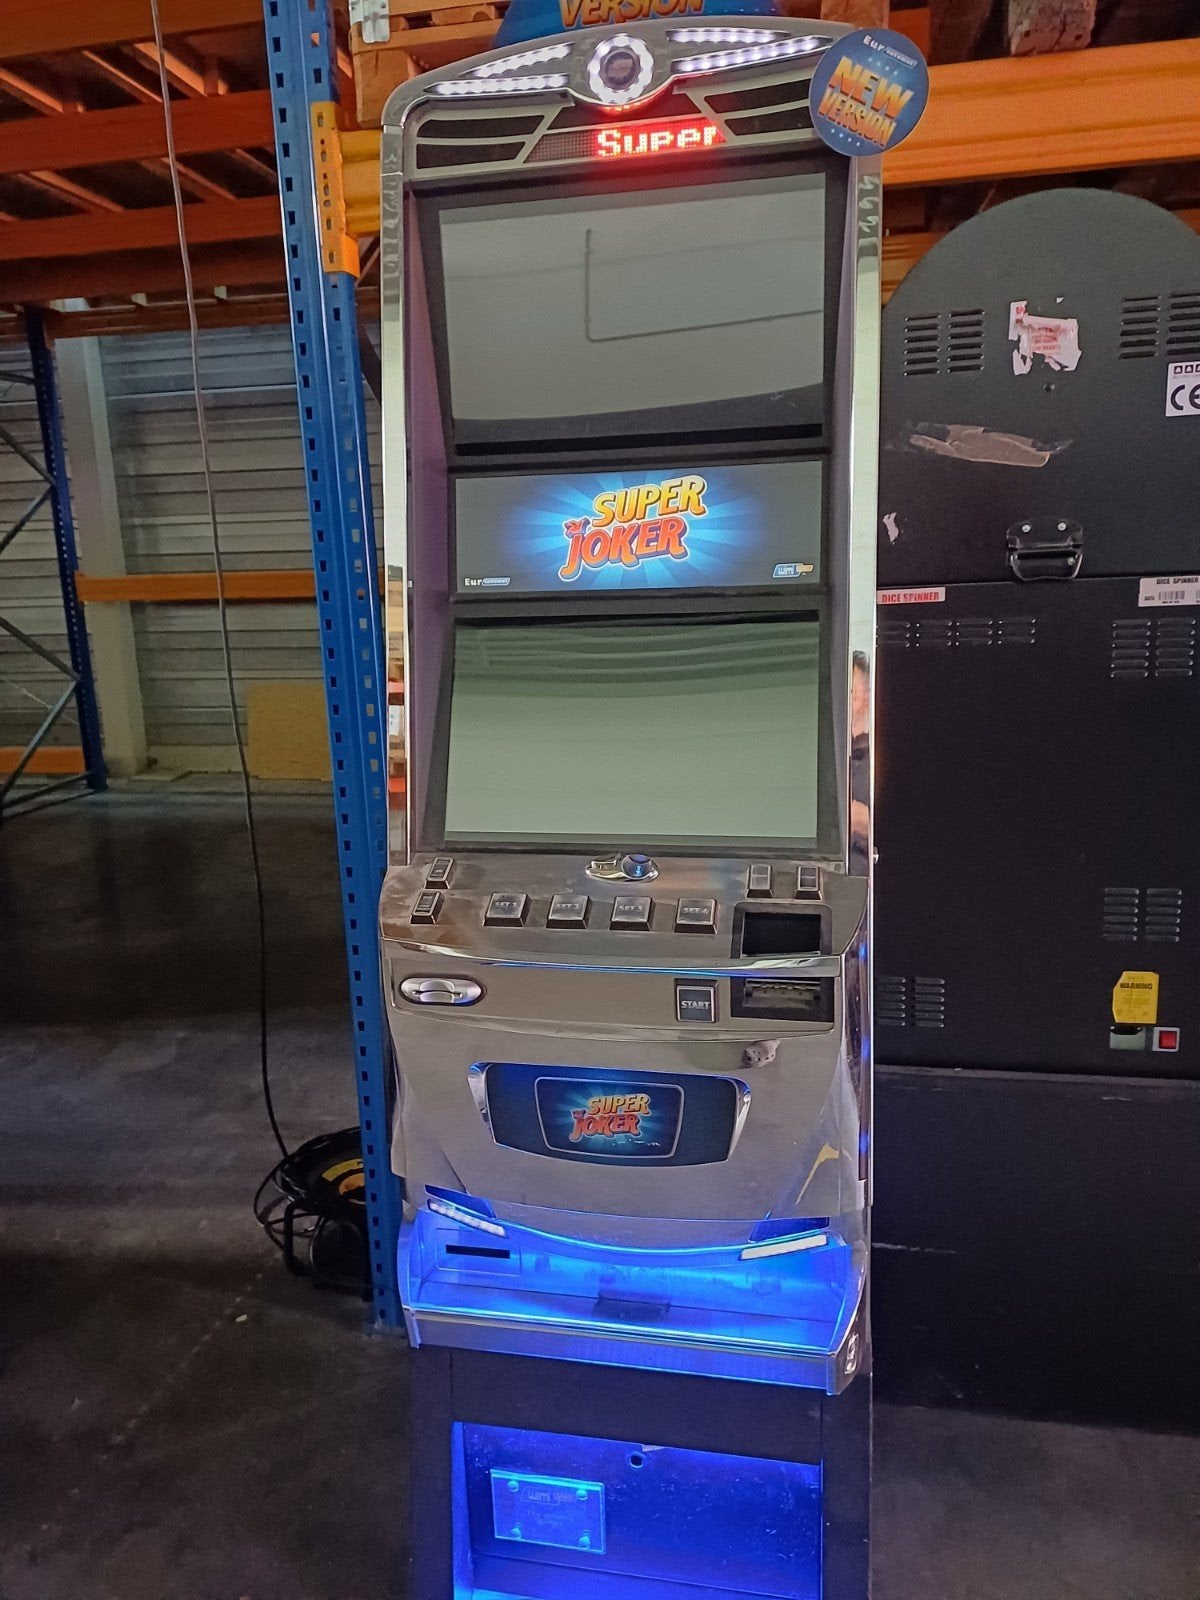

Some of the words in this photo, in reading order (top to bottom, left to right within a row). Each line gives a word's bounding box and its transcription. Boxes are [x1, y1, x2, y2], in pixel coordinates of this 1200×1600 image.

[828, 56, 915, 120] NEW
[817, 87, 898, 148] VERSION
[597, 126, 717, 157] Super
[592, 474, 708, 527] SUPER
[558, 516, 690, 582] JOKER
[881, 593, 902, 603] DICE
[903, 591, 940, 602] SPINNER
[1119, 982, 1153, 990] WARNING
[680, 1000, 711, 1010] START
[587, 1093, 651, 1115] SUPER
[568, 1111, 642, 1143] JOKER
